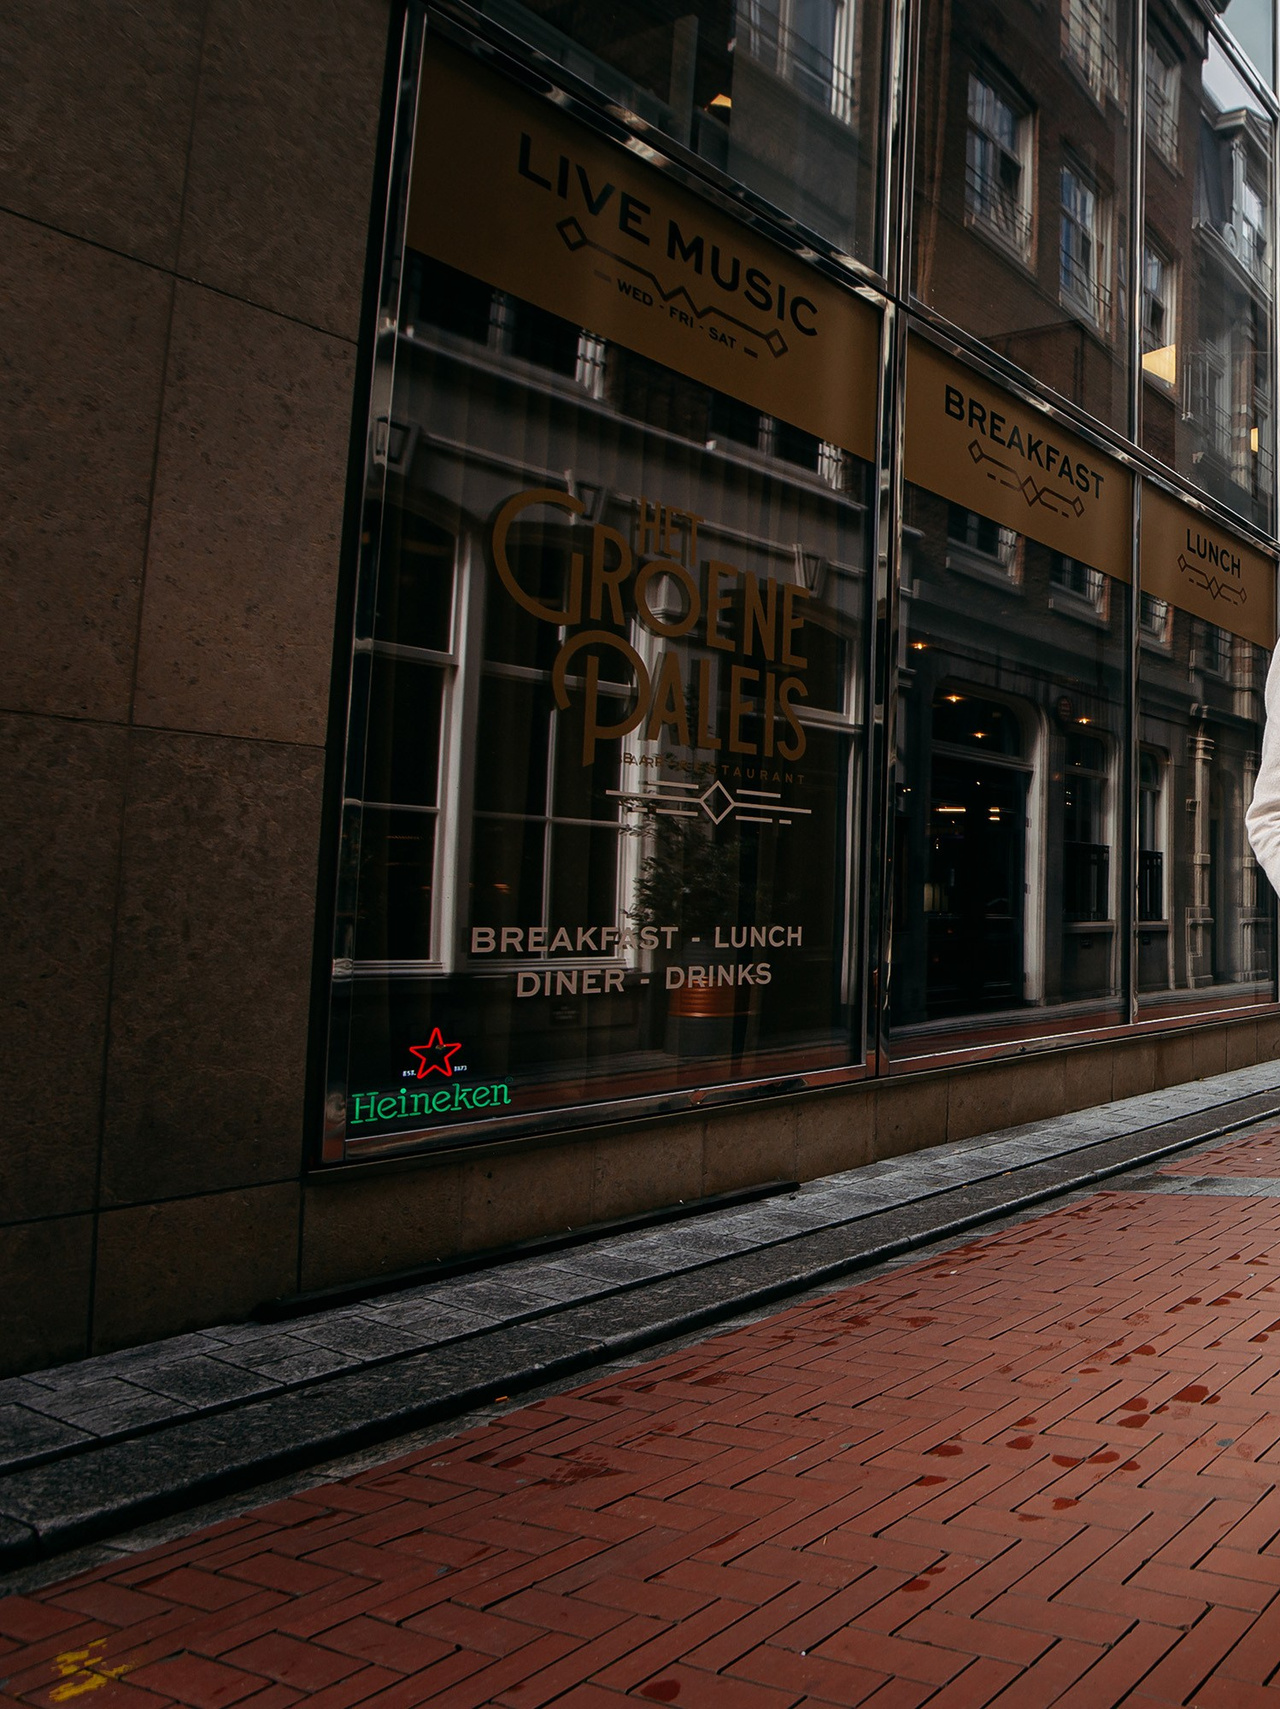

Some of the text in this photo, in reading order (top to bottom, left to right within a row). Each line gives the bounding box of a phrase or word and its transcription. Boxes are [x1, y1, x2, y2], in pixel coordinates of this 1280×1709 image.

[517, 131, 819, 336] LIVE MUSIC
[617, 278, 654, 308] WED
[669, 306, 694, 329] FRI
[708, 326, 738, 350] SAT
[944, 384, 1105, 499] BREAKFAST
[638, 496, 705, 566] HET
[1186, 528, 1241, 580] LUNCH
[492, 487, 811, 669] GROENE
[552, 629, 810, 768] PALEIS
[471, 926, 679, 954] BREAKFAST
[713, 925, 803, 949] LUNCH
[516, 968, 625, 998] DINER
[665, 962, 773, 990] DRINKS
[350, 1081, 513, 1126] Heineken
